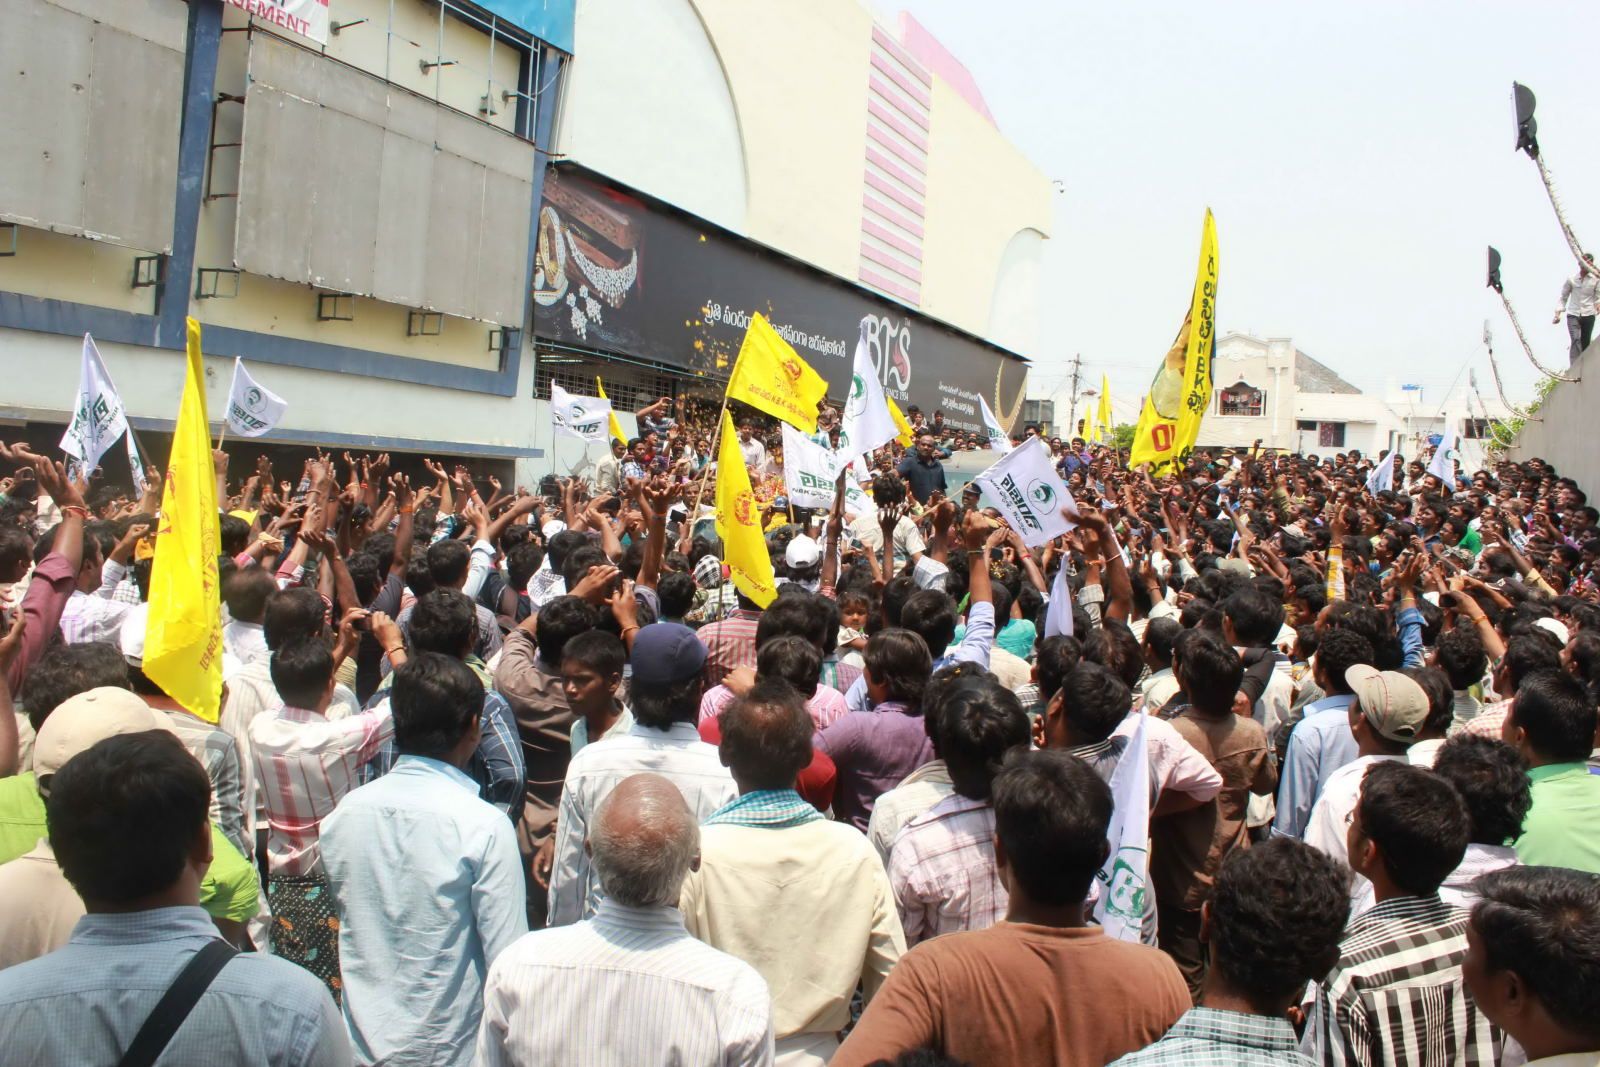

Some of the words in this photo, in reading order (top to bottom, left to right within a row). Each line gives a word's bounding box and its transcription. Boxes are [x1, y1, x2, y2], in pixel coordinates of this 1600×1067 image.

[227, 0, 311, 37] GEMENT
[704, 300, 721, 324] ప్రతి
[808, 335, 846, 358] జరుపుకోండి
[862, 313, 911, 392] BTS
